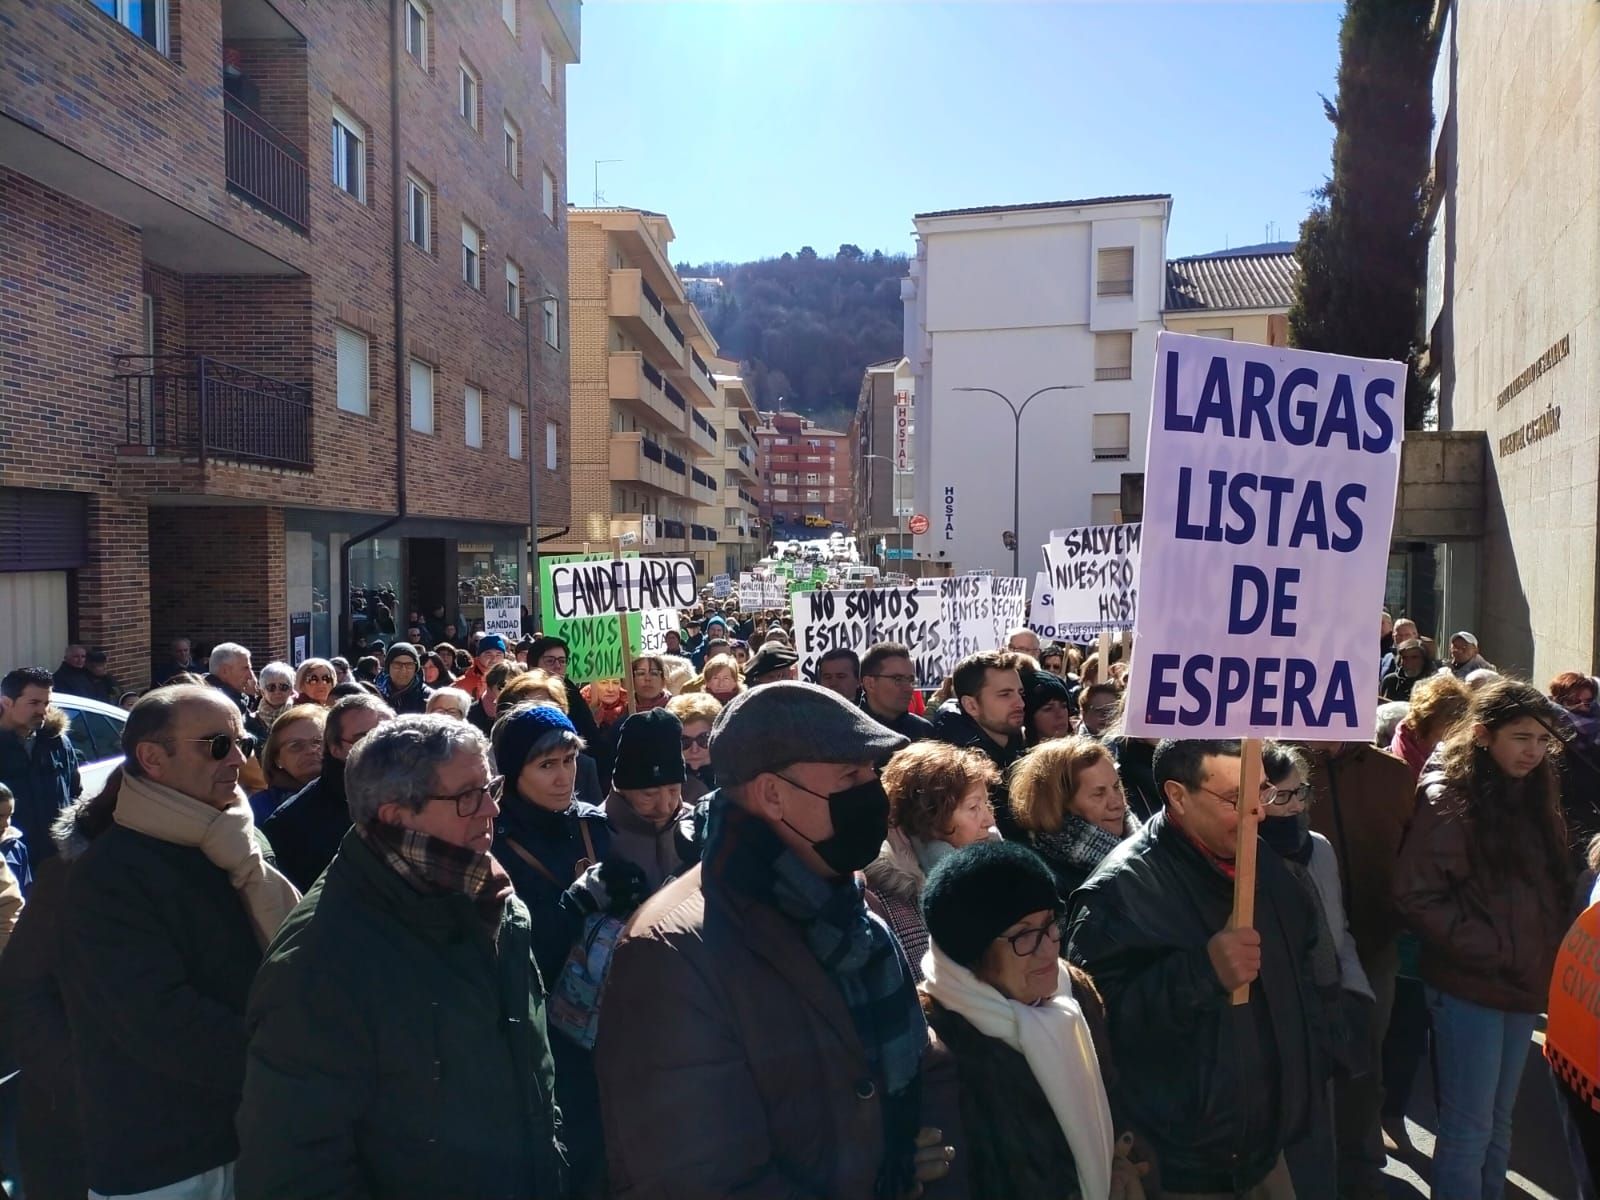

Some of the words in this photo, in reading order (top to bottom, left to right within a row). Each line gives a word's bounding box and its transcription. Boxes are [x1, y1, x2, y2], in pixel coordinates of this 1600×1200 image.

[1164, 351, 1395, 453] LARGAS
[898, 408, 906, 468] HOSTAL
[945, 486, 954, 540] HOSTAL
[1175, 467, 1367, 553] LISTAS
[553, 560, 698, 618] CANDELARIO
[941, 577, 980, 599] SOMOS
[1056, 559, 1134, 591] NUESTRO
[498, 609, 507, 618] LA
[810, 589, 835, 623] NO
[845, 587, 919, 620] SOMOS
[1227, 565, 1300, 637] DE
[486, 620, 519, 629] SANIDAD
[559, 616, 618, 649] SOMOS
[658, 613, 673, 631] EL
[805, 616, 940, 654] ESTADÍSTICAS
[950, 622, 961, 636] DE
[1145, 653, 1358, 728] ESPERA
